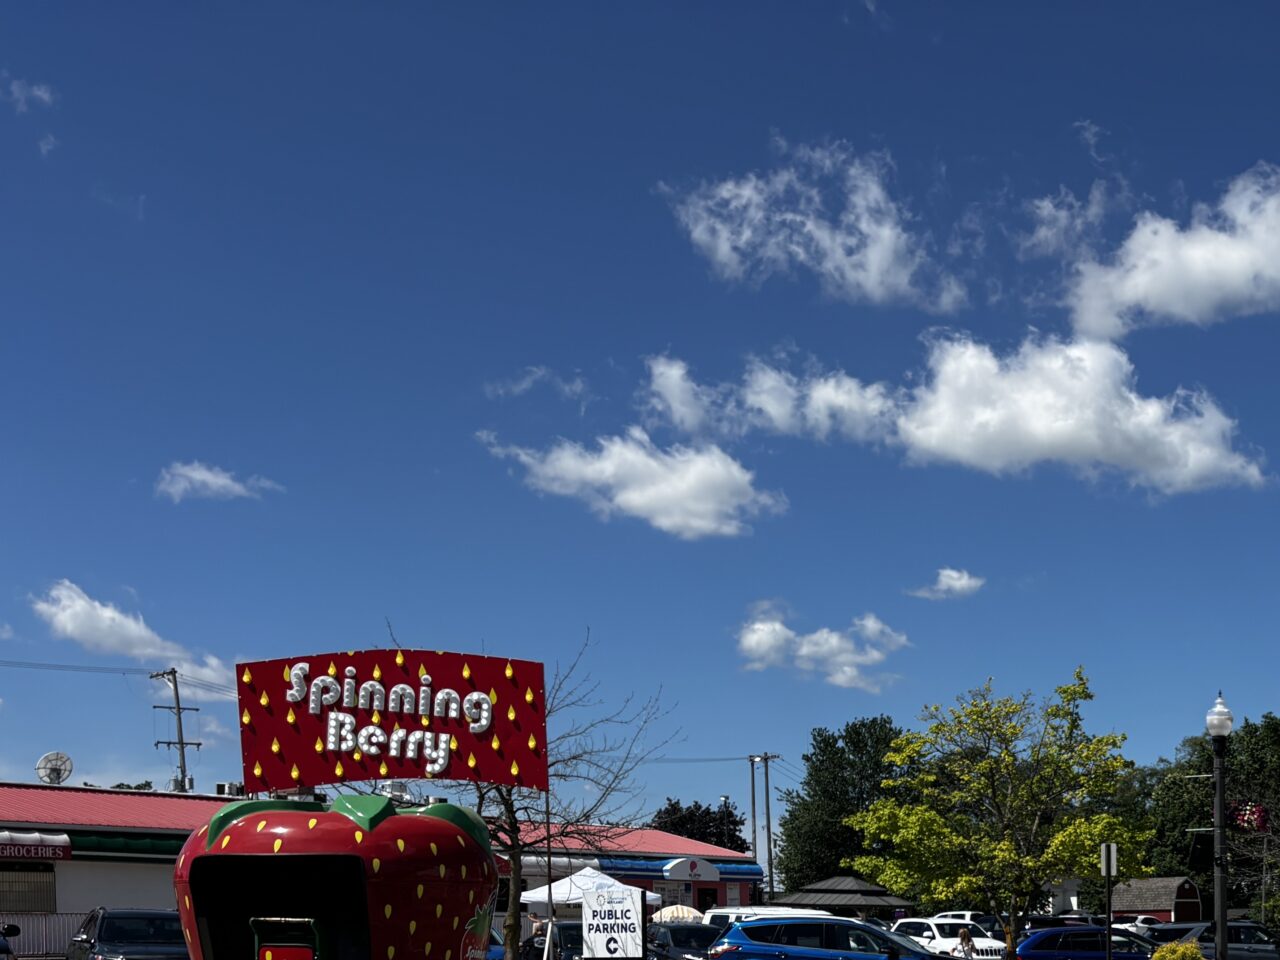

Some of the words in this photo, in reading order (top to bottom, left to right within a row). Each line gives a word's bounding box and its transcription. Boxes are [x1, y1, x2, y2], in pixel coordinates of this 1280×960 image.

[286, 662, 492, 733] Spinning
[327, 711, 450, 774] Berry
[0, 845, 63, 858] GROCERIES
[592, 909, 631, 920] PUBLIC
[588, 922, 636, 934] PARKING
